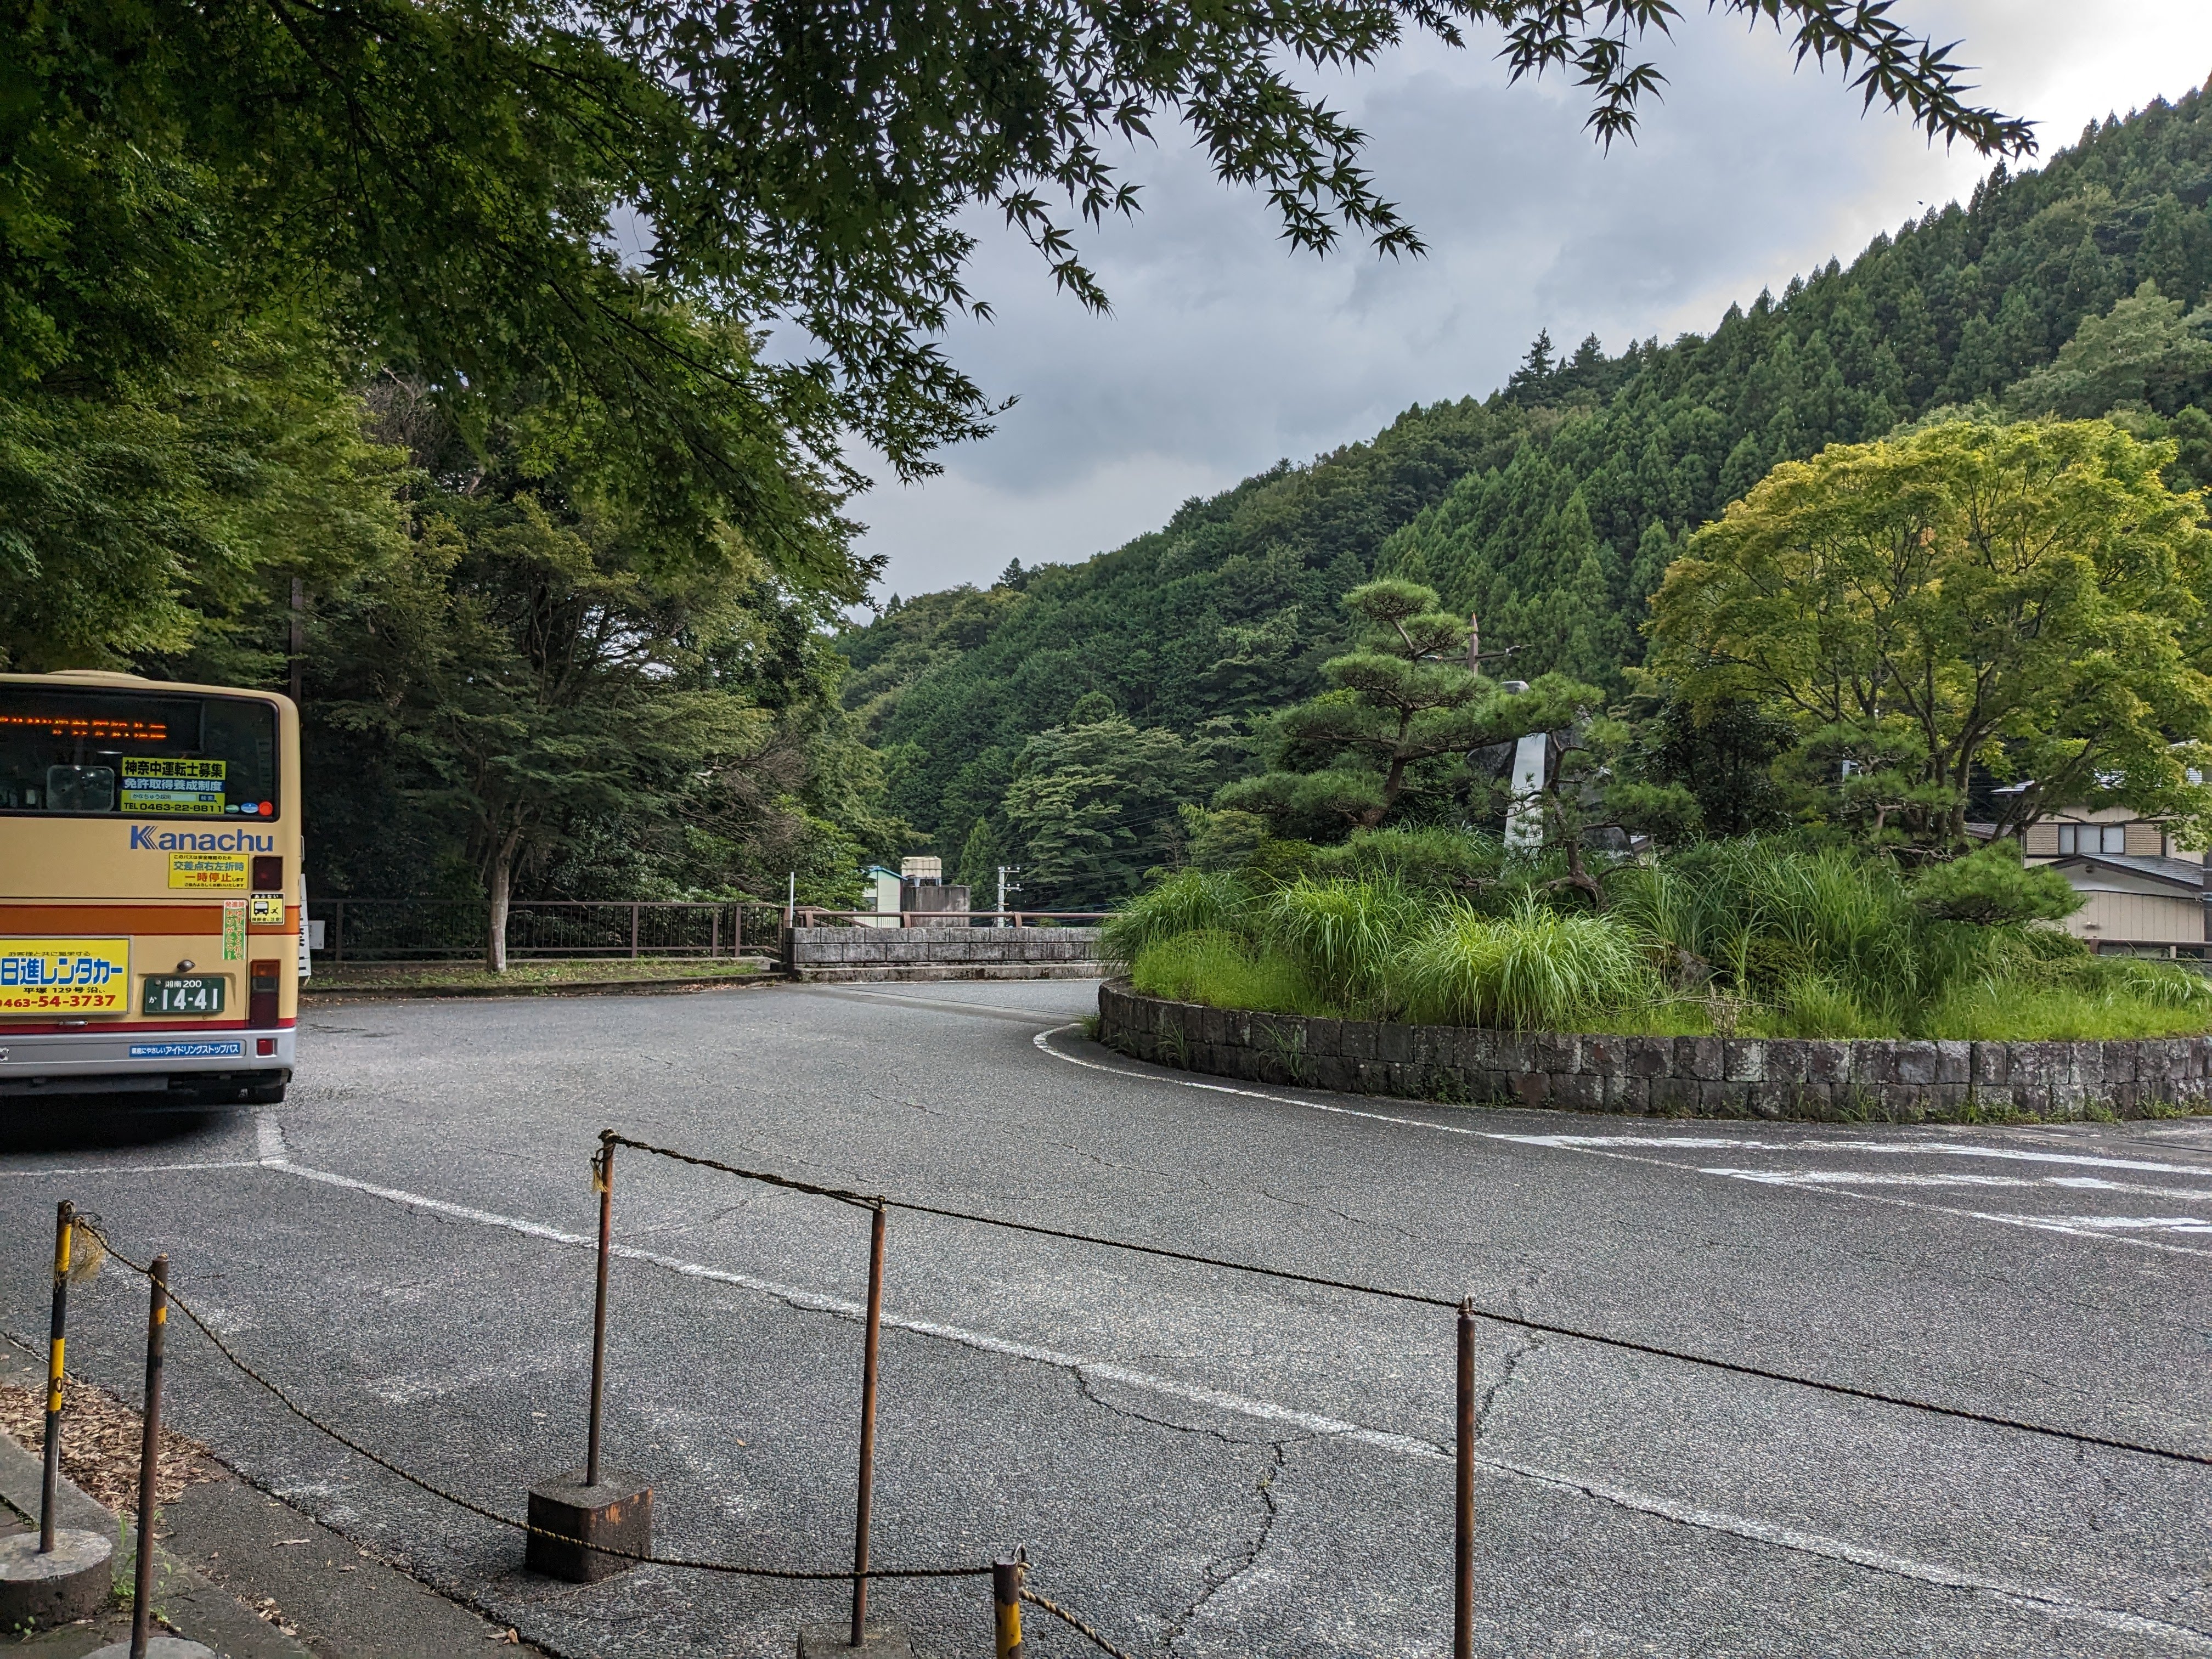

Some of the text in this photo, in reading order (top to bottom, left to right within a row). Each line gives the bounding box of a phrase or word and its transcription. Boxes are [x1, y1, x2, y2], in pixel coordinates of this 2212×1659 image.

[125, 760, 223, 778] 神奈中運転士募集
[124, 778, 223, 792] 免許取得養成制度
[139, 803, 221, 812] 0463-22-8811
[131, 825, 273, 851] Kanachu
[173, 861, 245, 871] 交差点右左折時
[1, 958, 123, 986] 日進レンタカー
[162, 989, 218, 1010] 14-41
